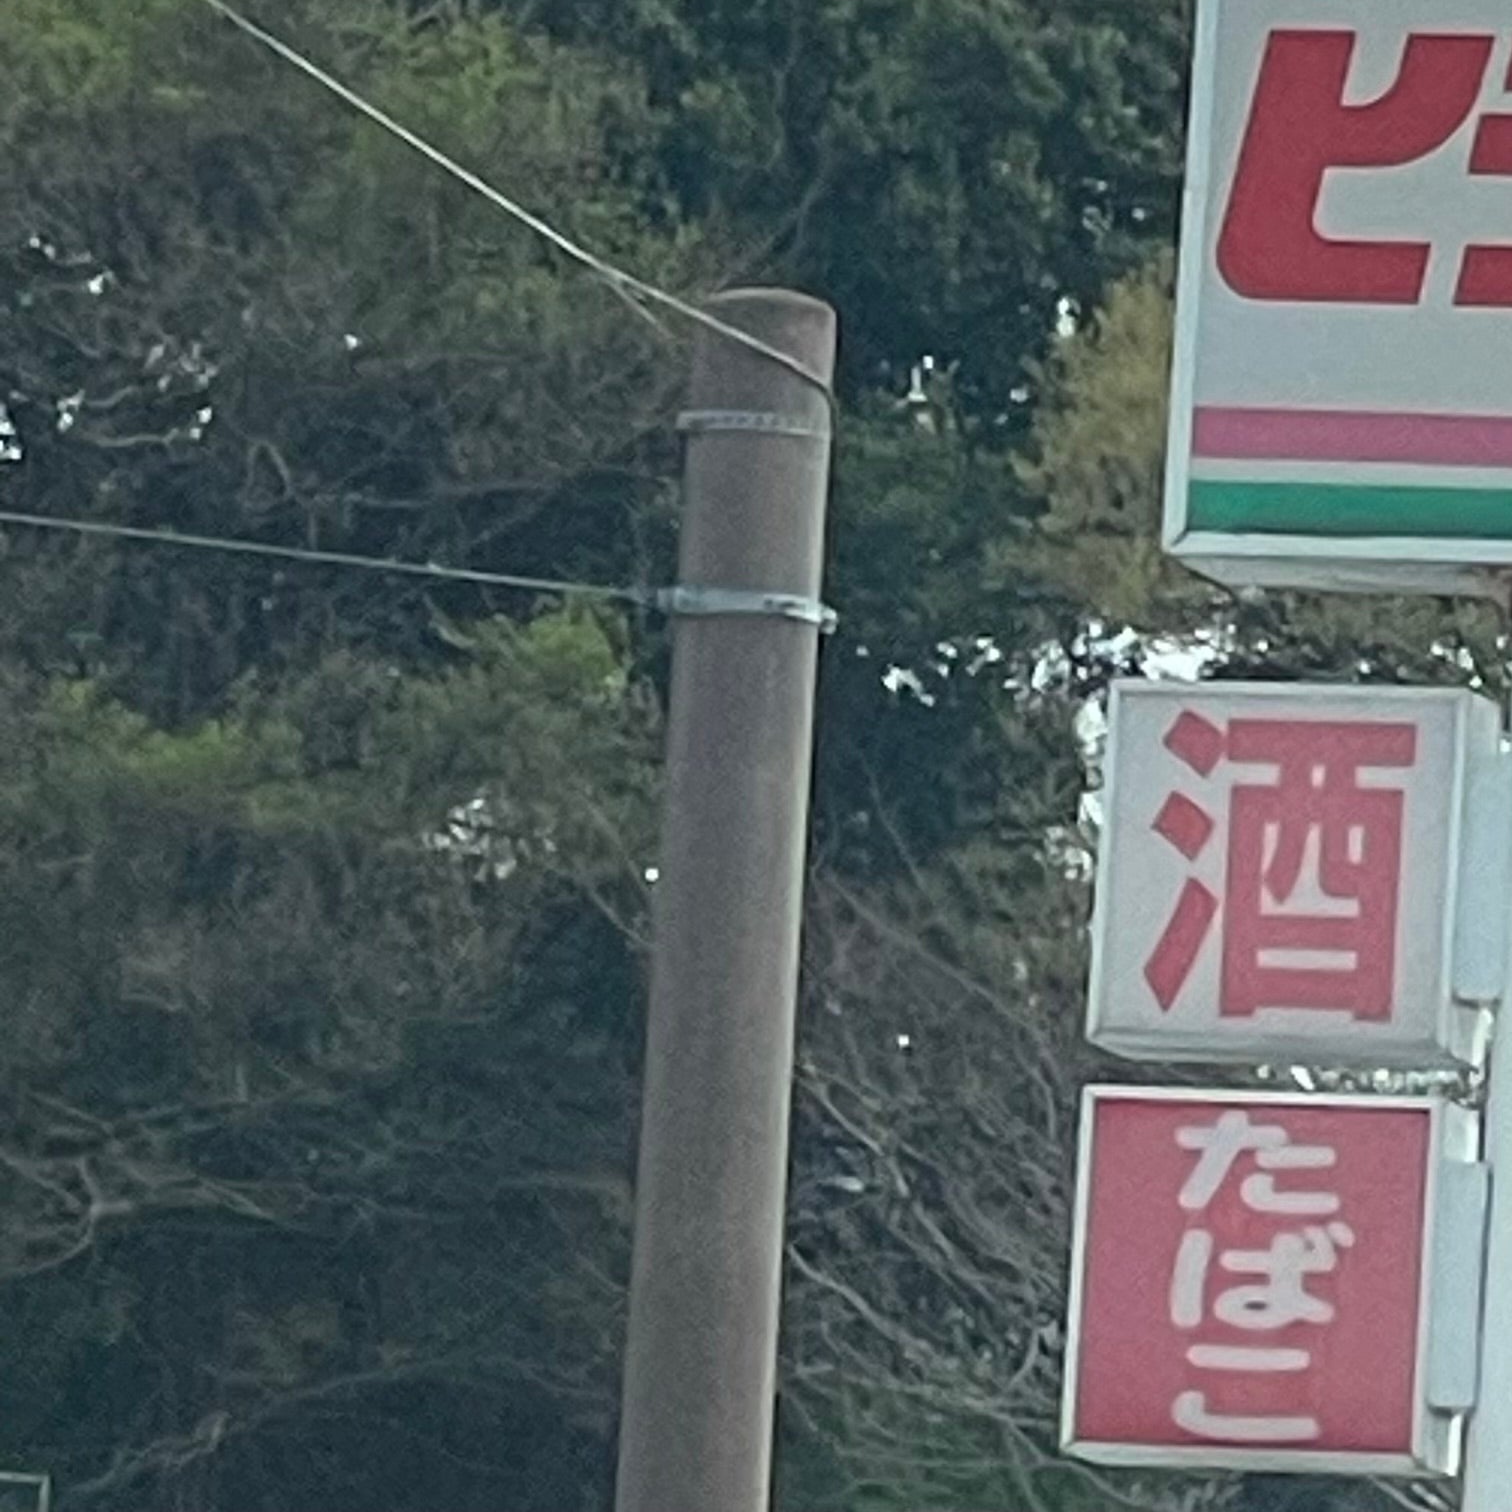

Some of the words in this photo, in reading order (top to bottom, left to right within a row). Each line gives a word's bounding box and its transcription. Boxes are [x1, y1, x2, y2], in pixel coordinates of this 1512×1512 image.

[1143, 709, 1417, 1022] 酒
[1170, 1110, 1355, 1441] たばこ
